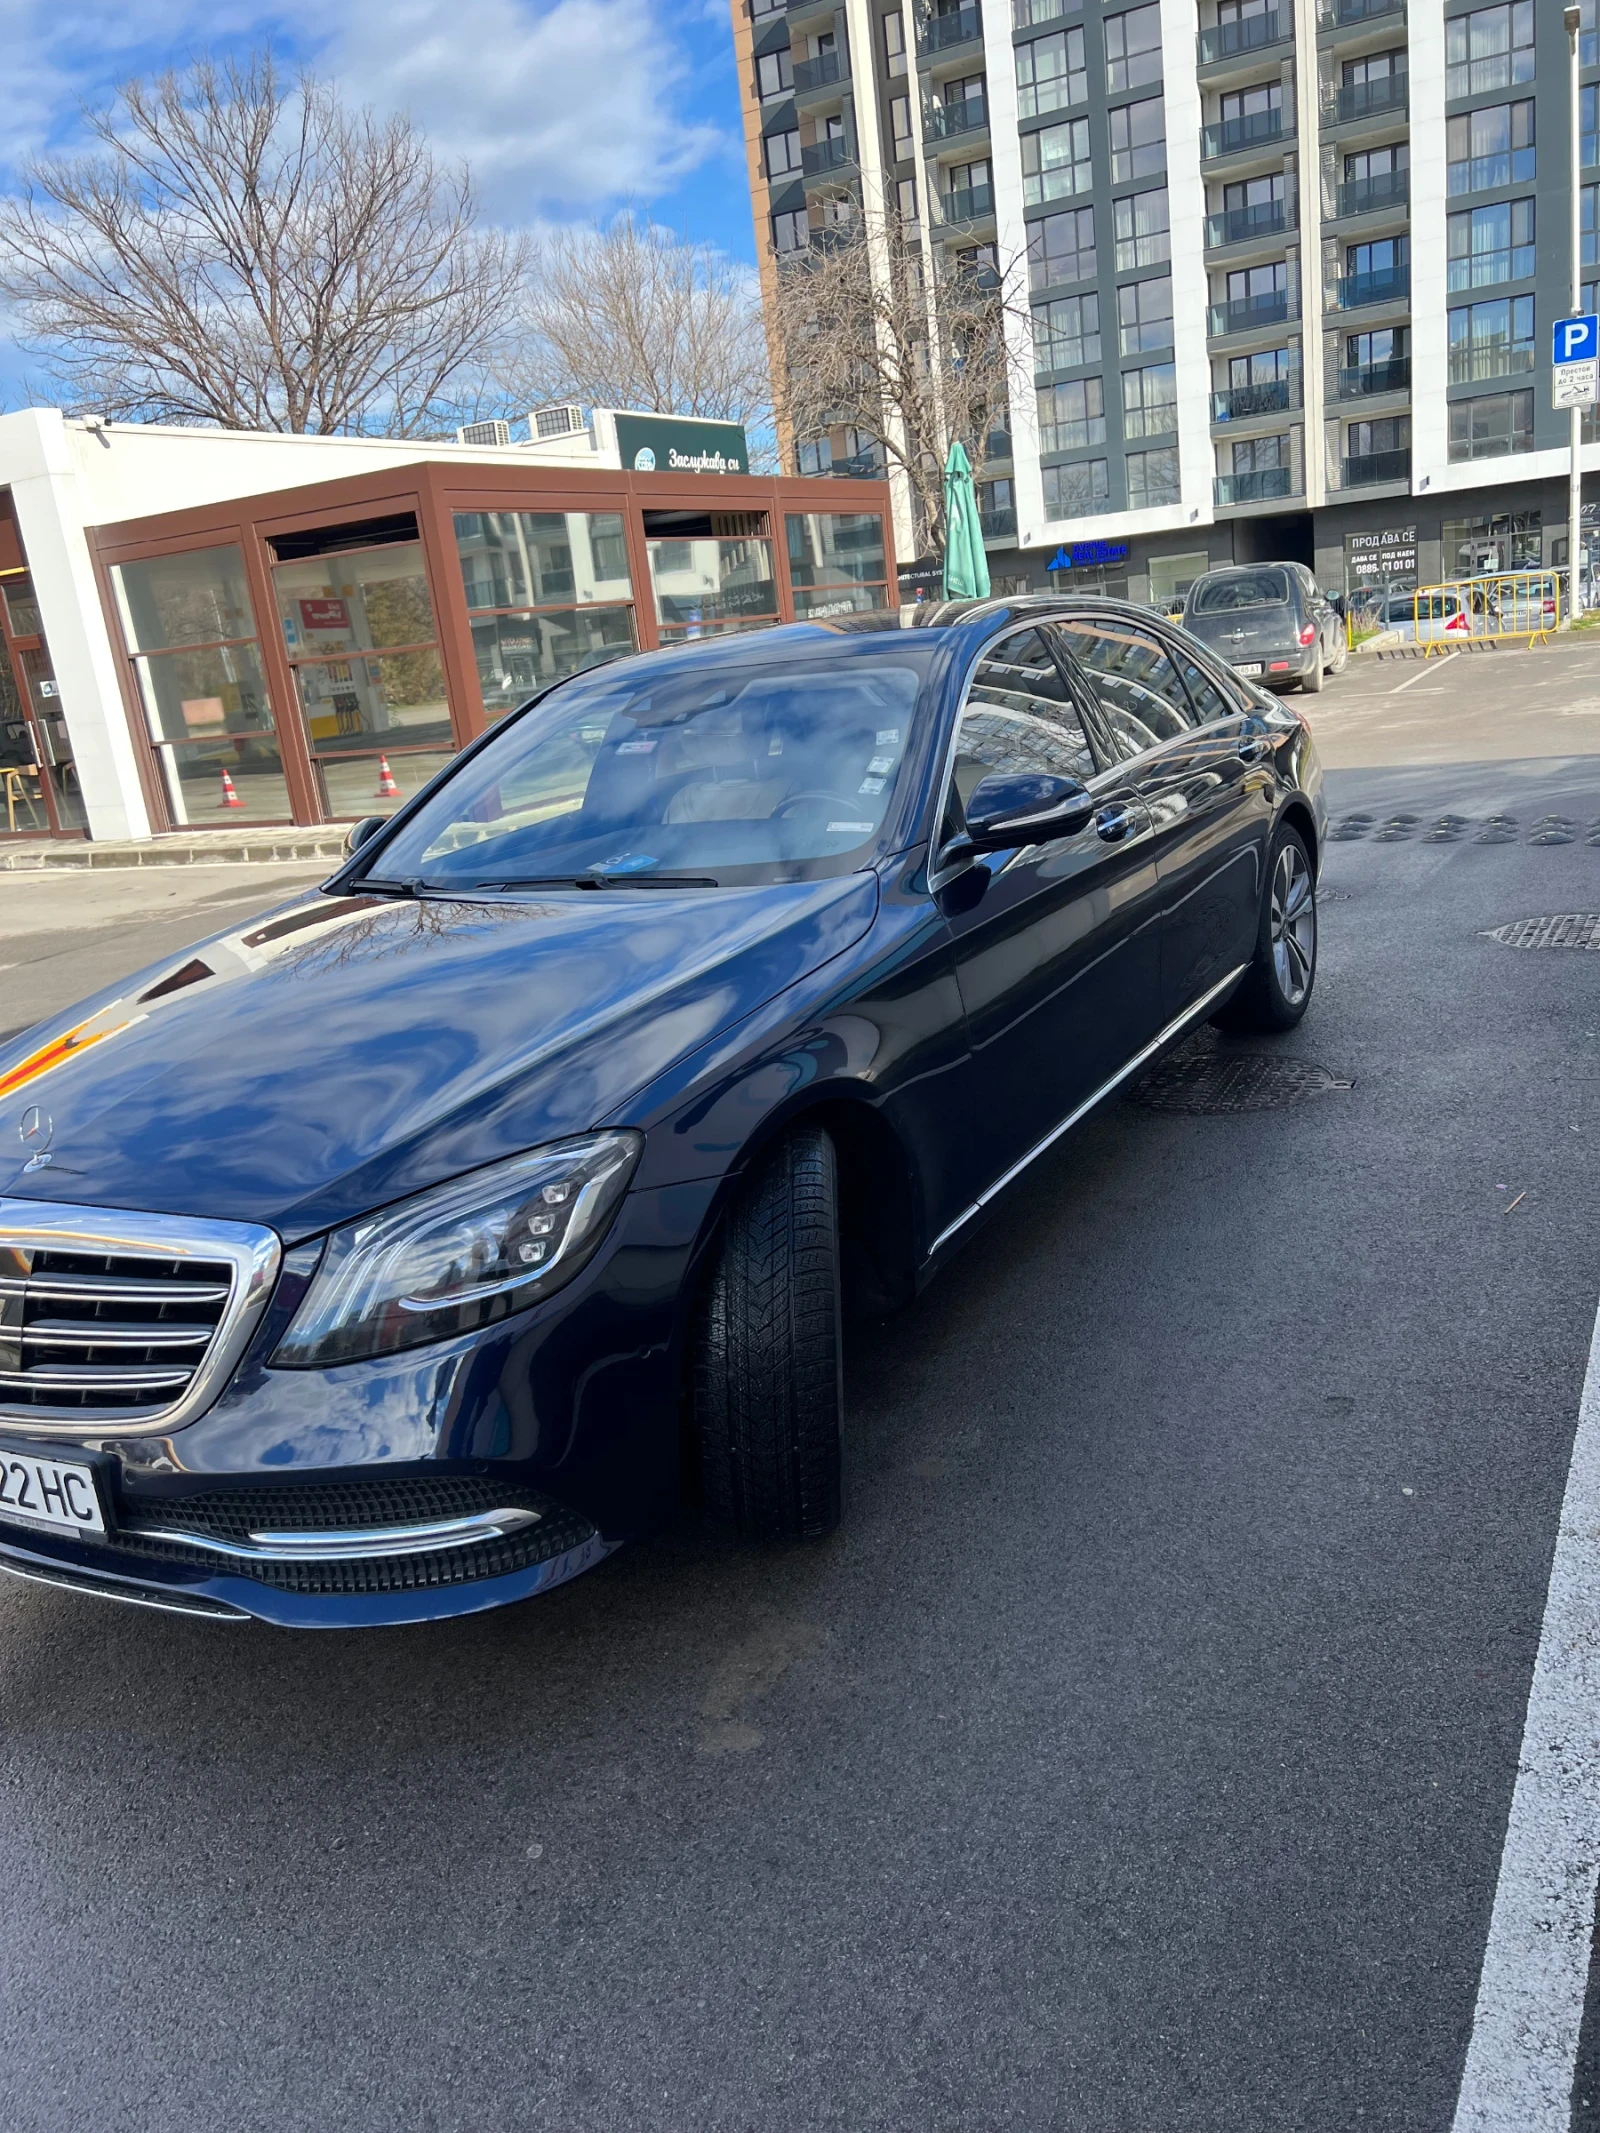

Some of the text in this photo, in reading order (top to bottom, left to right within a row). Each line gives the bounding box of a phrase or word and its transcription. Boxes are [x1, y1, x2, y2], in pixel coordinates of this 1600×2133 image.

[1564, 323, 1589, 357] P
[1569, 375, 1574, 383] 2
[1576, 373, 1594, 381] часа
[1073, 540, 1107, 551] AVENUE
[1352, 531, 1415, 548] ПРОДАВА СЕ
[1073, 544, 1127, 560] REAL ESTATE
[1351, 556, 1368, 564] ДАВА
